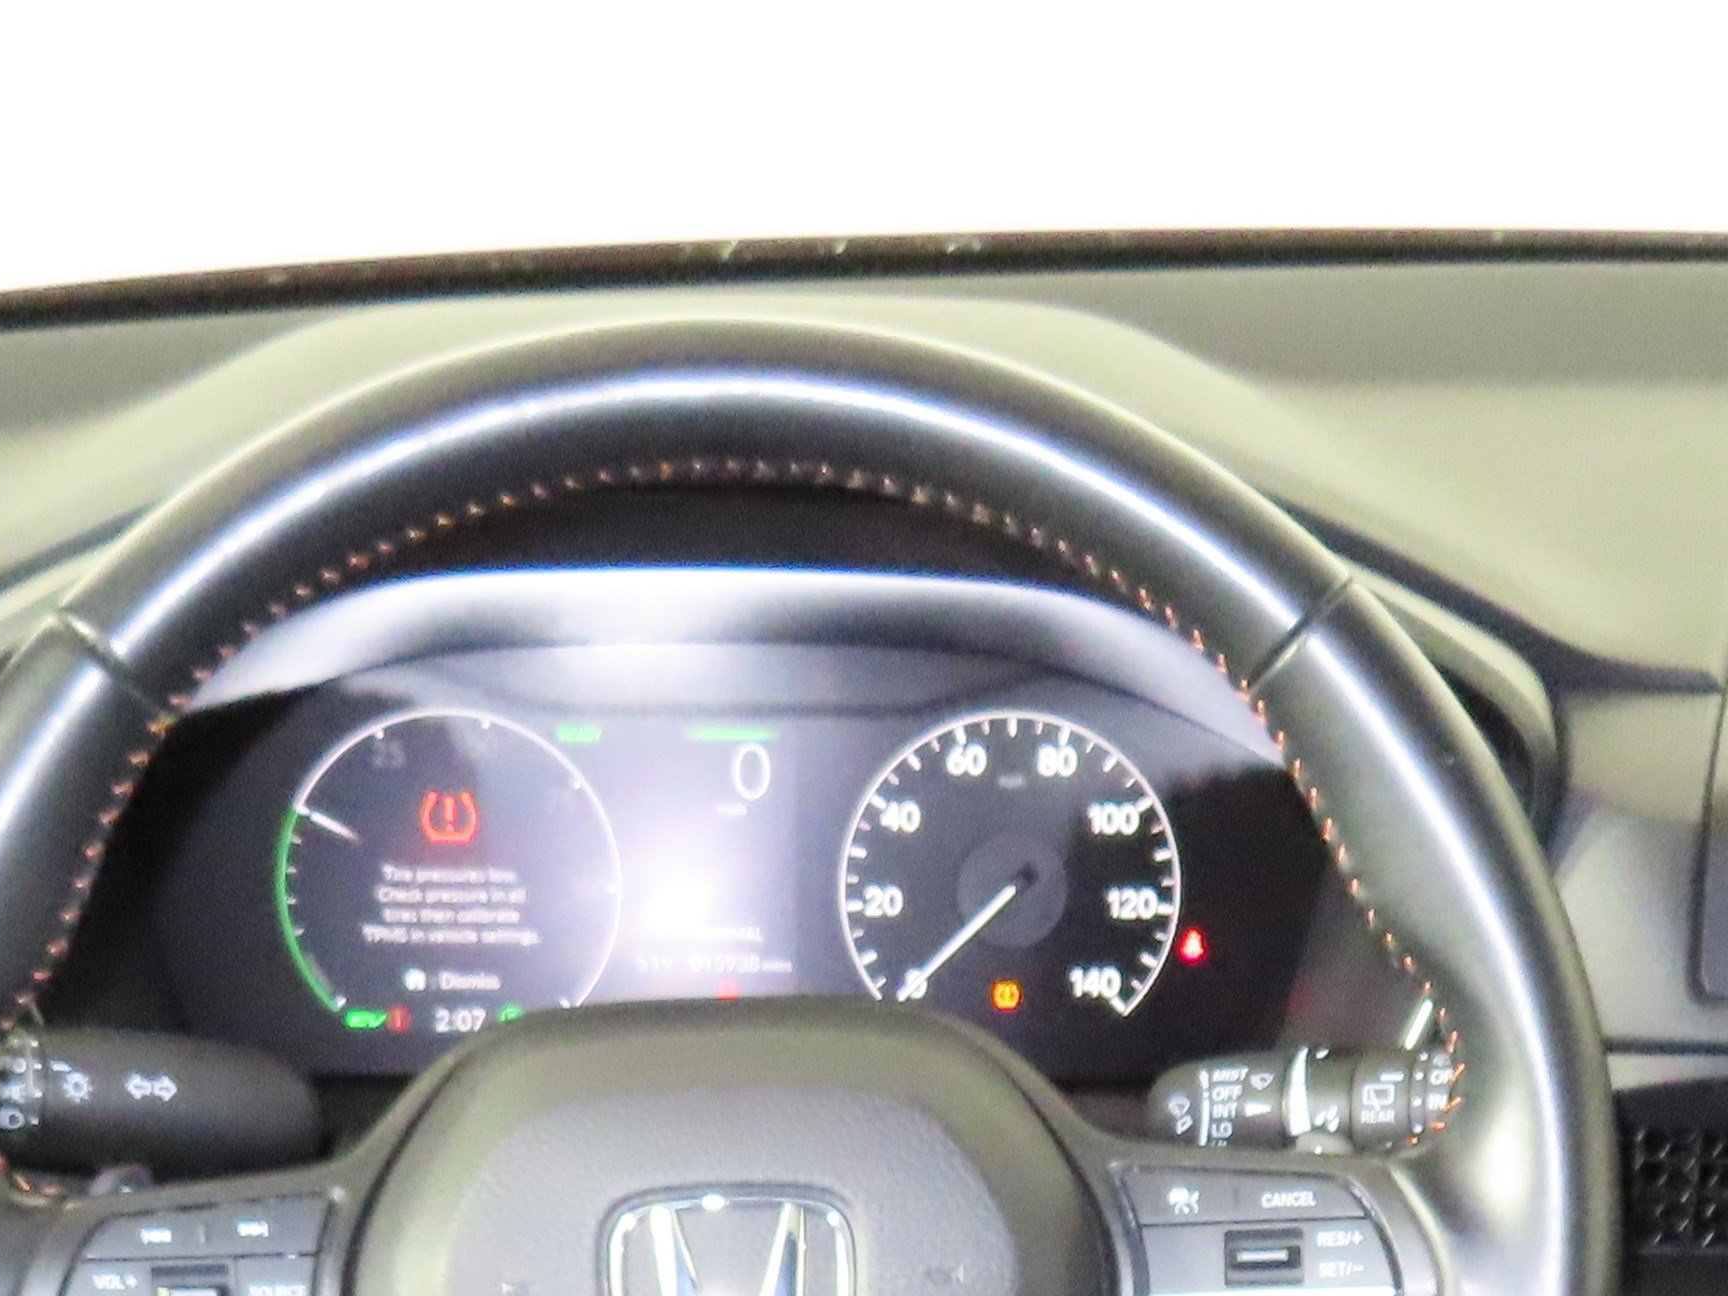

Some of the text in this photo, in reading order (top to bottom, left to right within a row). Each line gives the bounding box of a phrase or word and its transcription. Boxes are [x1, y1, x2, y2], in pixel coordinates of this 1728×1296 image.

[733, 743, 771, 800] 0
[946, 746, 985, 776] 60
[1036, 746, 1076, 776] 80
[881, 802, 921, 832] 40
[1087, 804, 1138, 836] 100
[864, 885, 902, 917] 20
[1106, 887, 1157, 918] 120
[1070, 967, 1122, 999] 140
[433, 1005, 487, 1034] 2:07
[1212, 1066, 1249, 1083] MIST
[1212, 1084, 1243, 1102] OFF
[1212, 1120, 1234, 1138] LO
[1260, 1190, 1318, 1209] CANCEL
[92, 1273, 125, 1290] VOL
